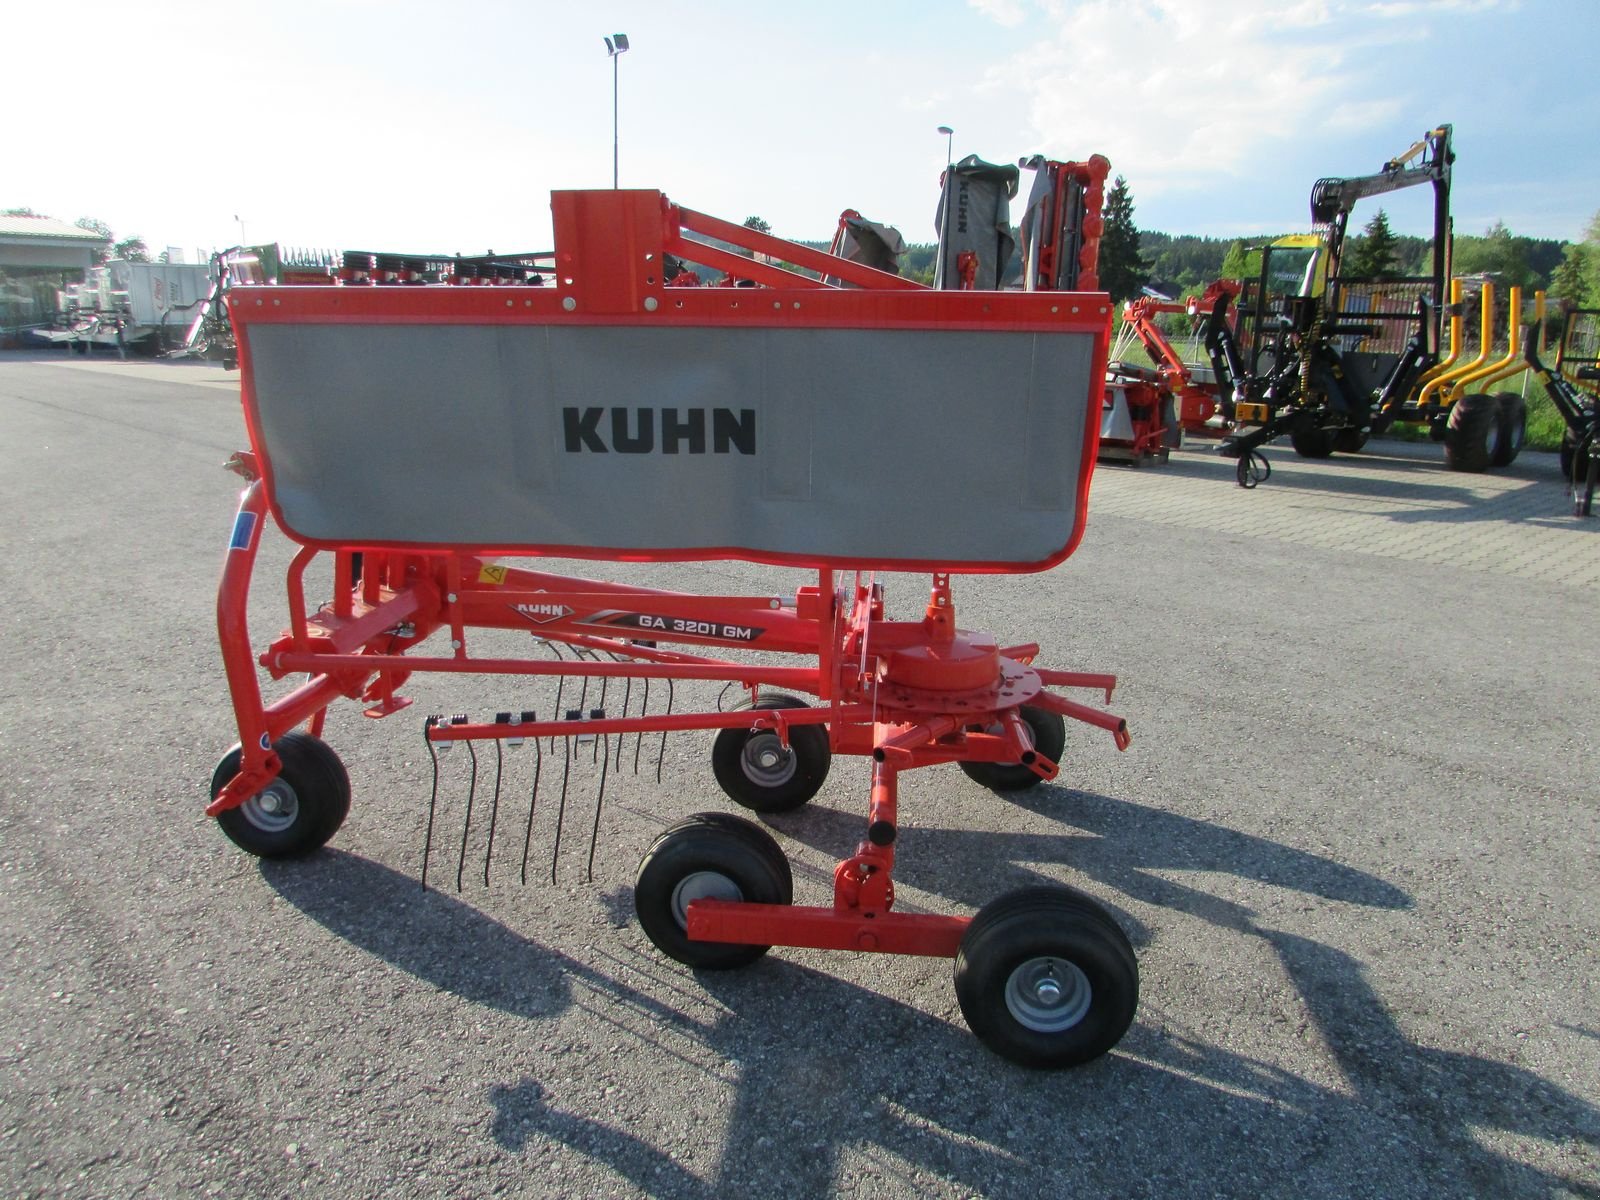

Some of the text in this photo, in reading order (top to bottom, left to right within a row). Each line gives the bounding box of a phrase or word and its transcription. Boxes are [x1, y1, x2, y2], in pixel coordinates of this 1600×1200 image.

[958, 181, 969, 233] KUHN
[563, 407, 756, 455] KUHN
[639, 615, 752, 640] GA 3201 GM
